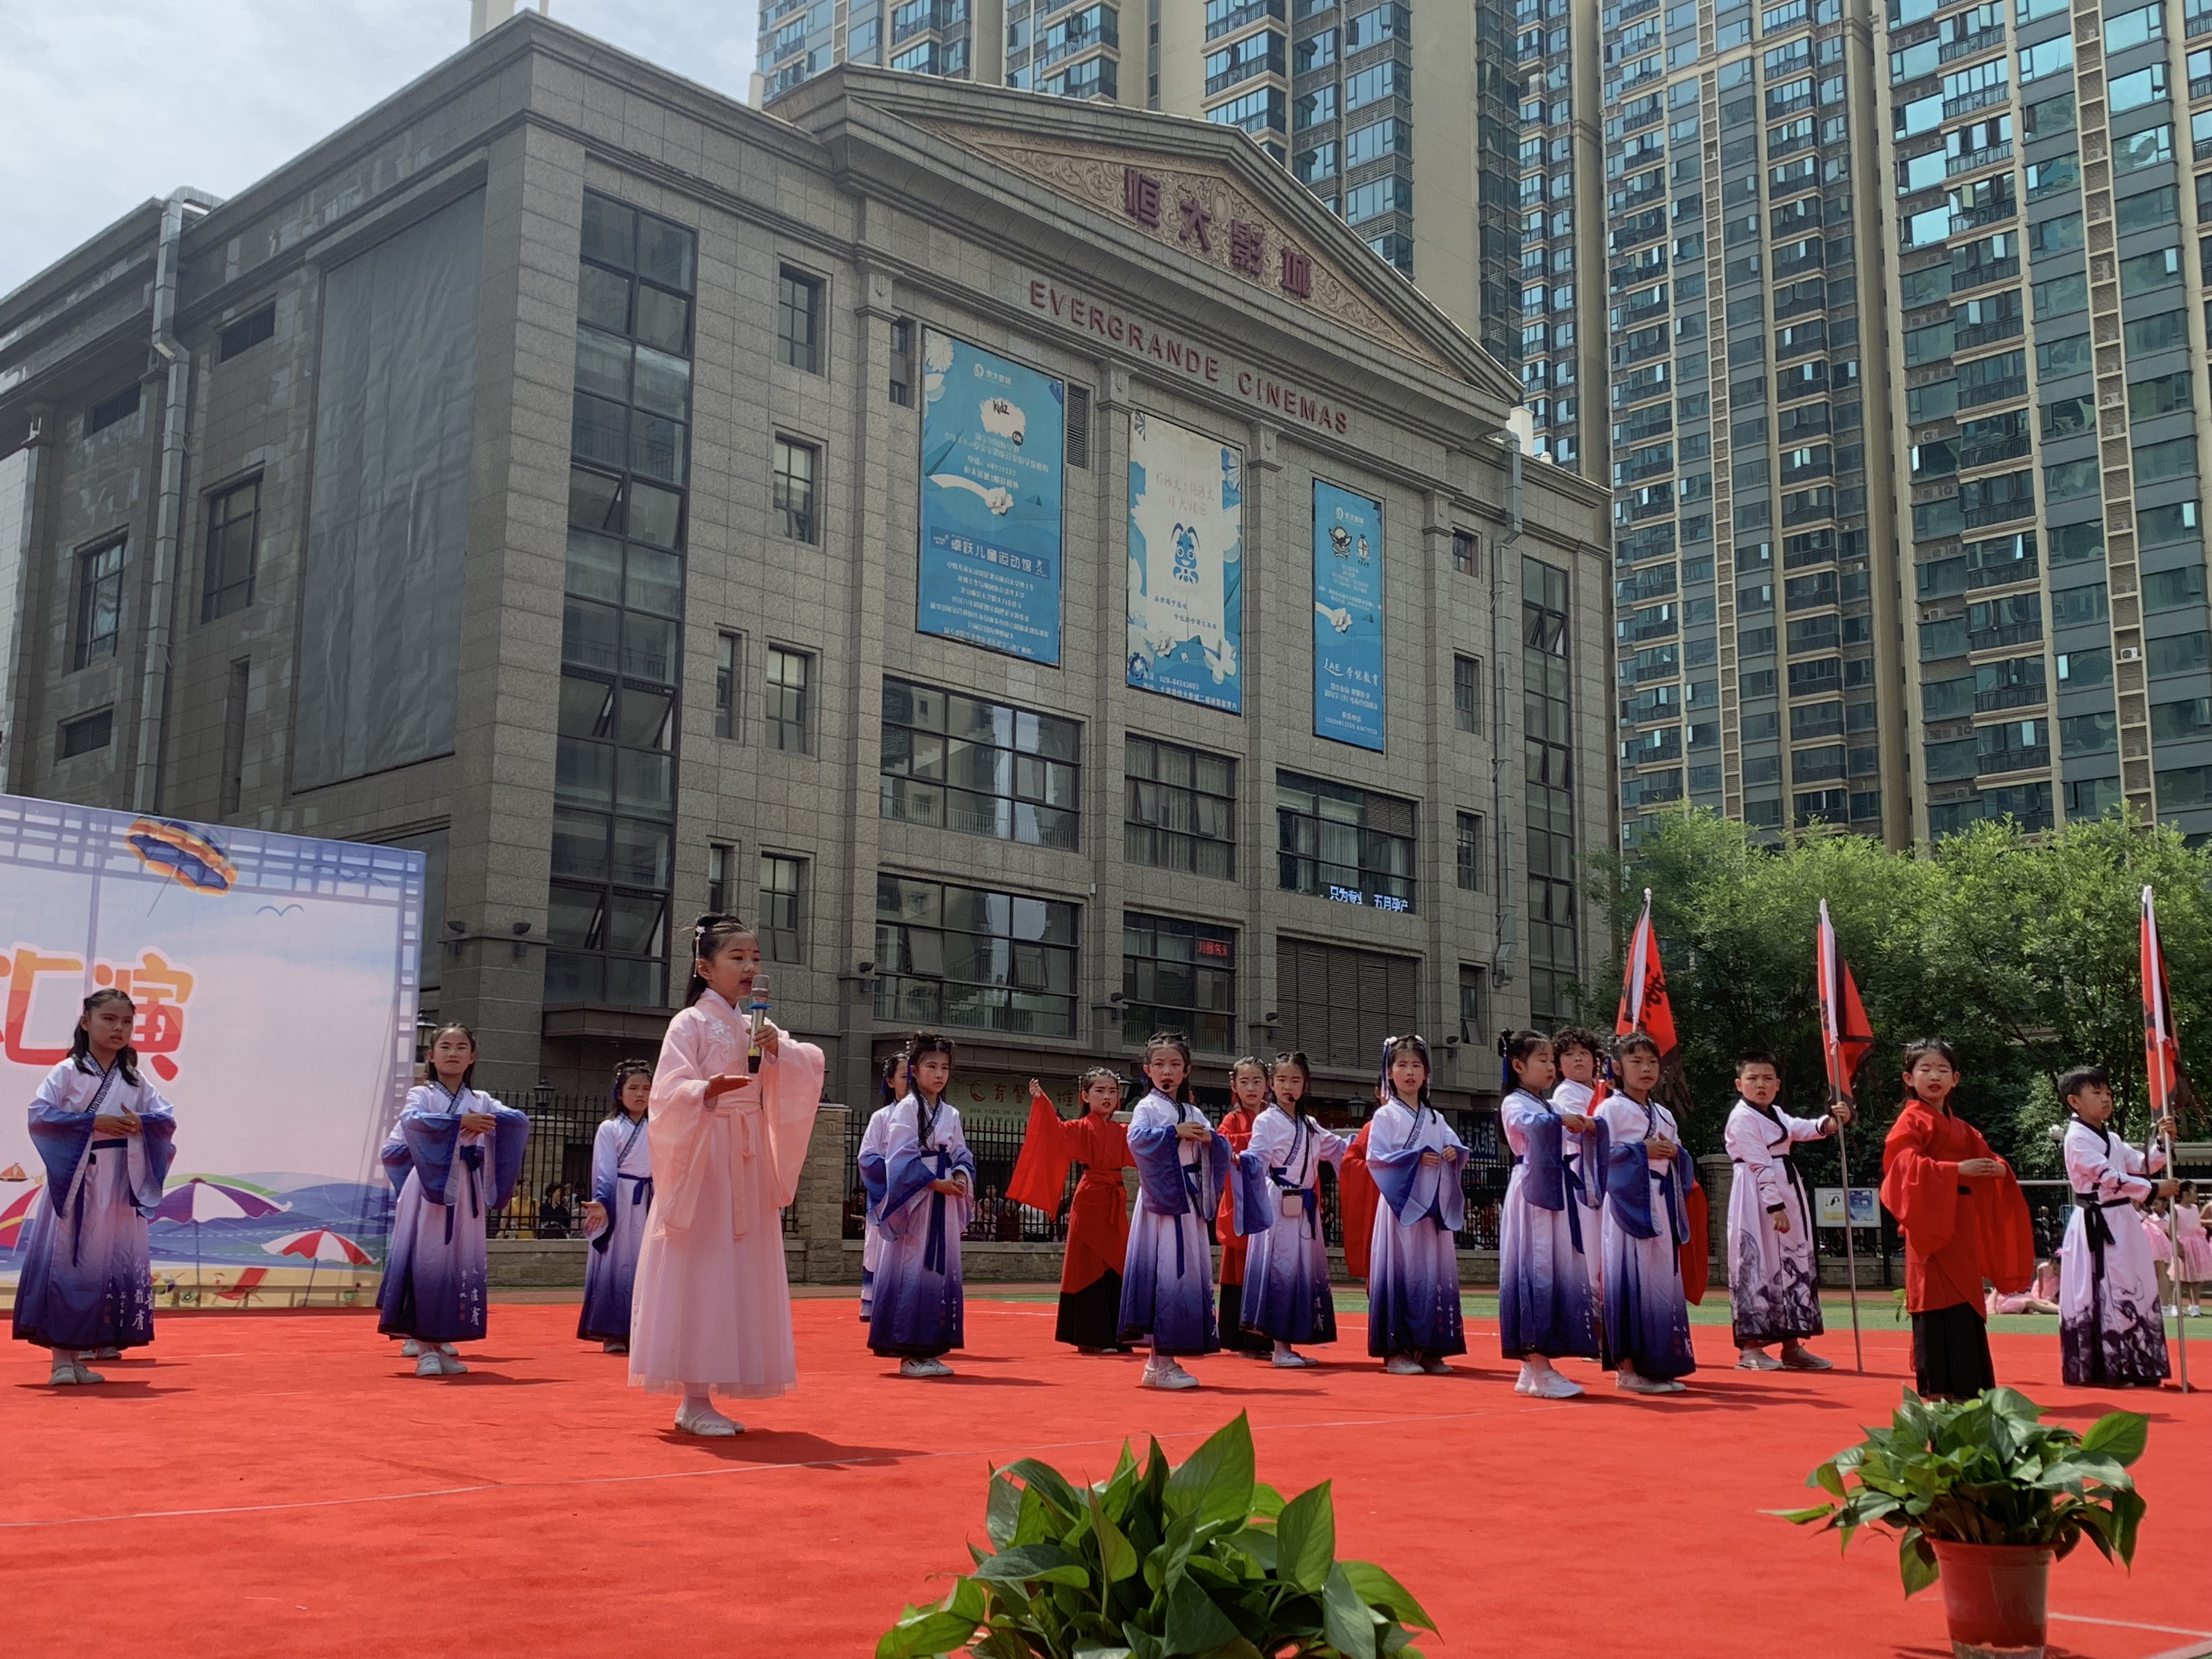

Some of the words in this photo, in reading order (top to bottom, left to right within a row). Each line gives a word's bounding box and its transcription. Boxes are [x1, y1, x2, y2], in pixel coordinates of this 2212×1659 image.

[1124, 166, 1312, 300] 恒大影城
[1030, 280, 1220, 382] EVERGRANDE
[1238, 371, 1348, 435] CINEMAS
[1013, 433, 1022, 444] UK
[950, 538, 1032, 572] 卓跃儿童运动馆
